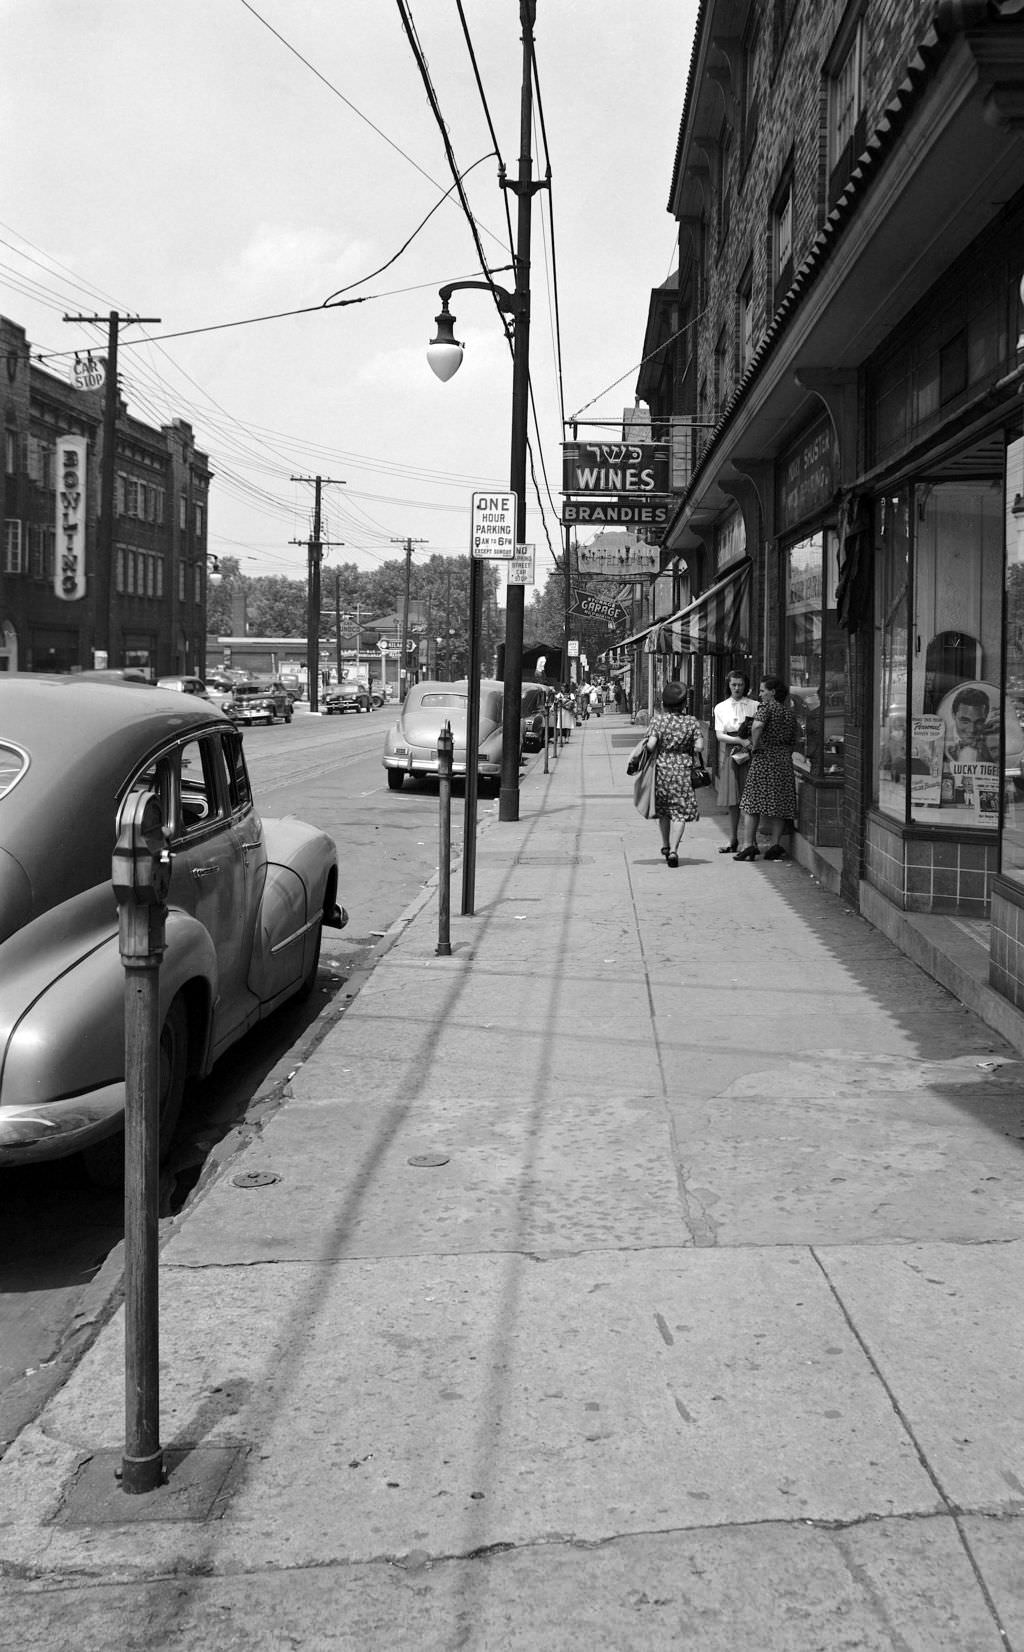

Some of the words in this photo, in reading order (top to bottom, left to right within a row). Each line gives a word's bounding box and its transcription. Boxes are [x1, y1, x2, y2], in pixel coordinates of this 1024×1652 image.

[73, 360, 99, 375] CAR
[75, 373, 102, 389] STOP
[576, 467, 655, 491] WINES
[478, 498, 510, 511] ONE
[60, 450, 81, 594] BOWLING
[482, 513, 505, 523] HOUR
[565, 507, 667, 522] BRANDIES
[475, 525, 511, 535] PARKING
[515, 547, 528, 555] NO
[581, 600, 621, 618] GARAGE
[953, 764, 978, 775] LUCKY
[980, 765, 999, 776] TIGE
